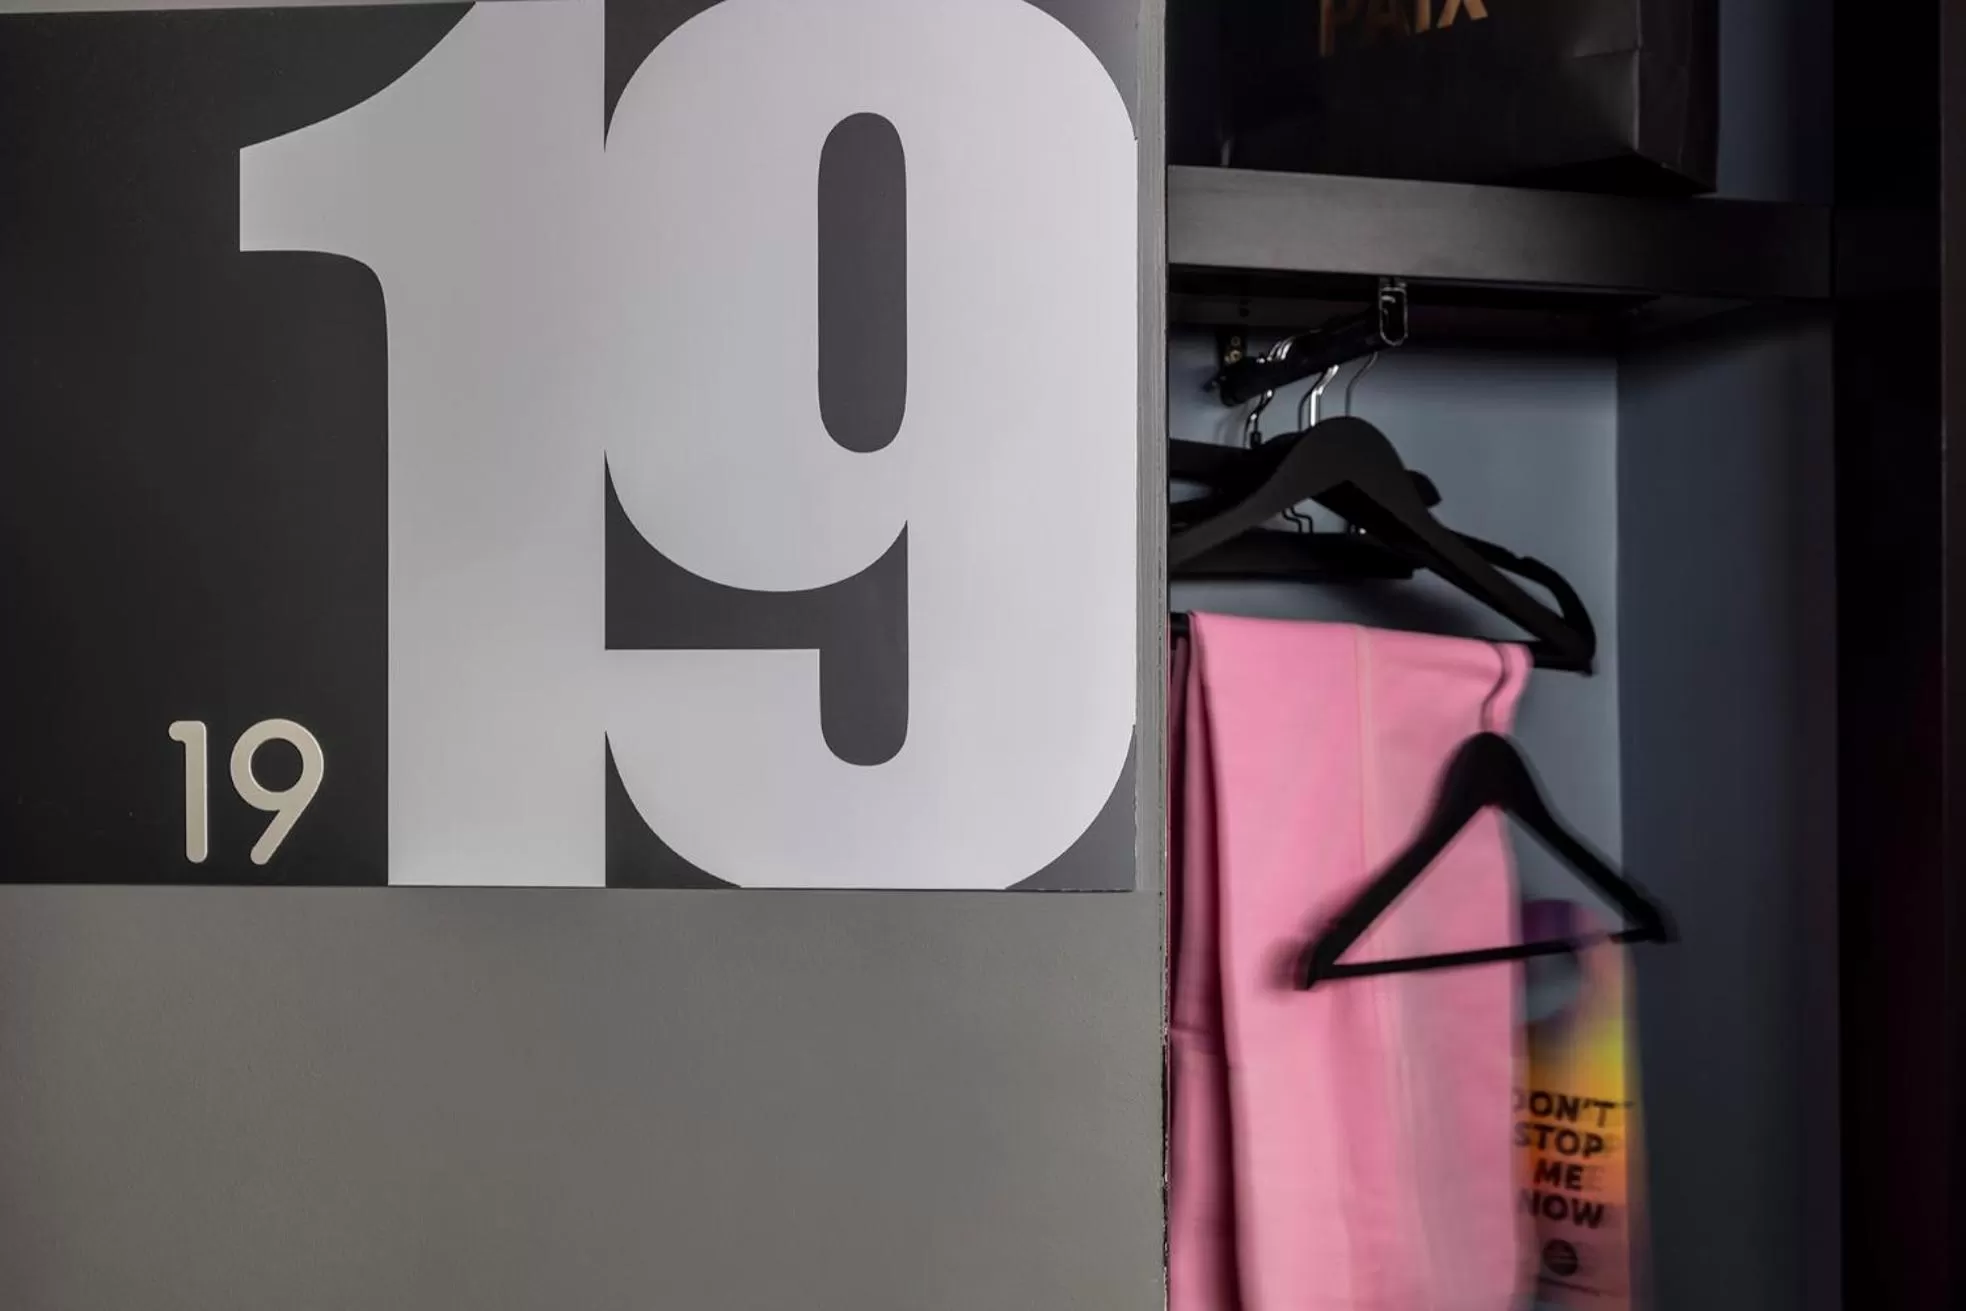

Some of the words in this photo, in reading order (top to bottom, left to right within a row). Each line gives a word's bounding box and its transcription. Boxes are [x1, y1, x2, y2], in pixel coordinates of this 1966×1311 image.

[1319, 0, 1488, 57] PA
[239, 0, 1138, 889] 19
[167, 718, 325, 865] 19
[1513, 1121, 1605, 1160] STOP
[1533, 1157, 1584, 1193] ME
[1518, 1189, 1605, 1230] NOW
